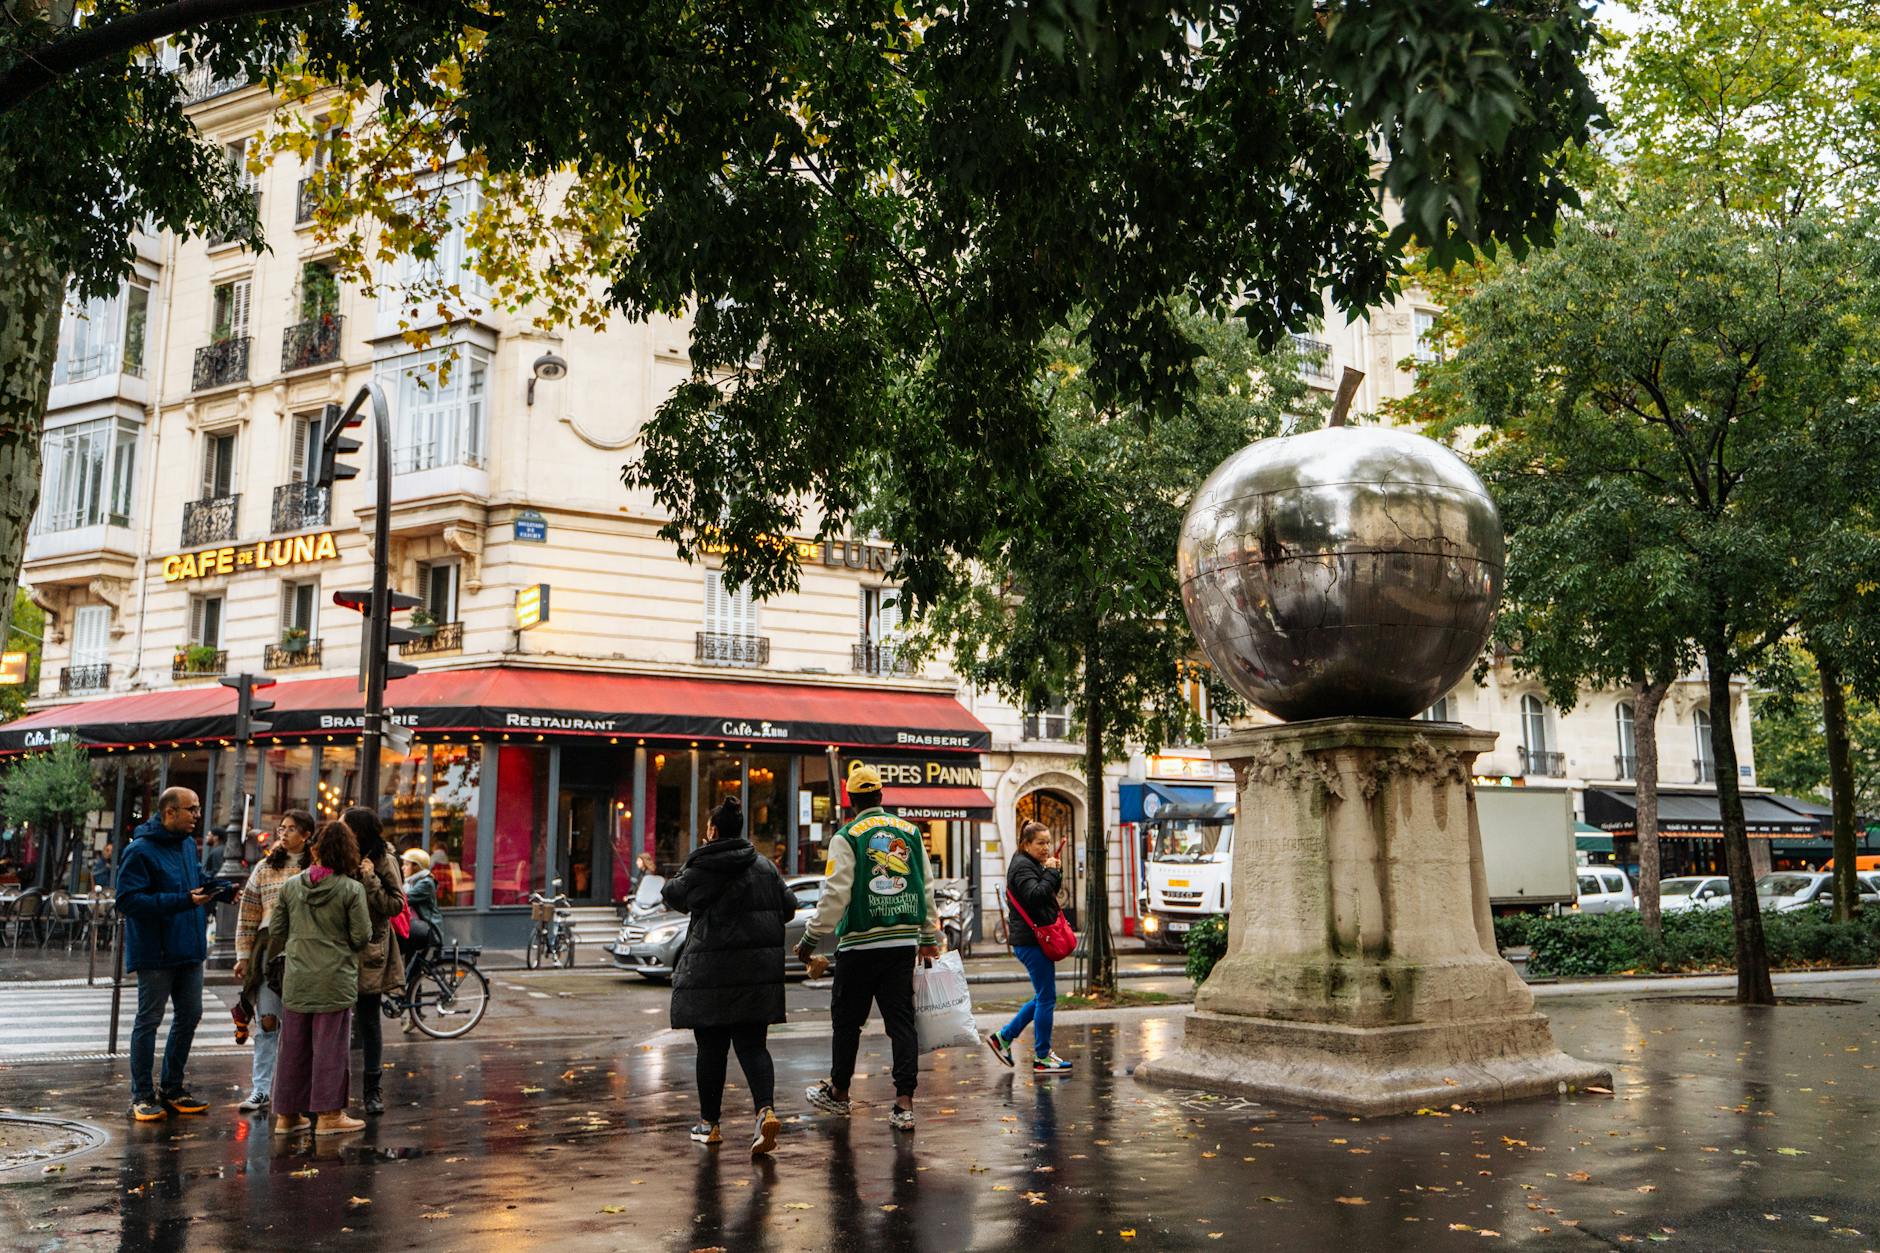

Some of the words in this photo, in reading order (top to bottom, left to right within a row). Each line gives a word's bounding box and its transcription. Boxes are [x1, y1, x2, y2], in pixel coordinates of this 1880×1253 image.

[162, 547, 235, 583] CAFE
[256, 532, 337, 569] LUNA
[825, 540, 909, 572] LUN
[320, 714, 419, 728] BRASRIE
[506, 714, 616, 730] RESTAURANT
[722, 721, 752, 736] Café
[897, 732, 970, 747] BRASSERIE
[897, 808, 968, 818] SANDWICHS
